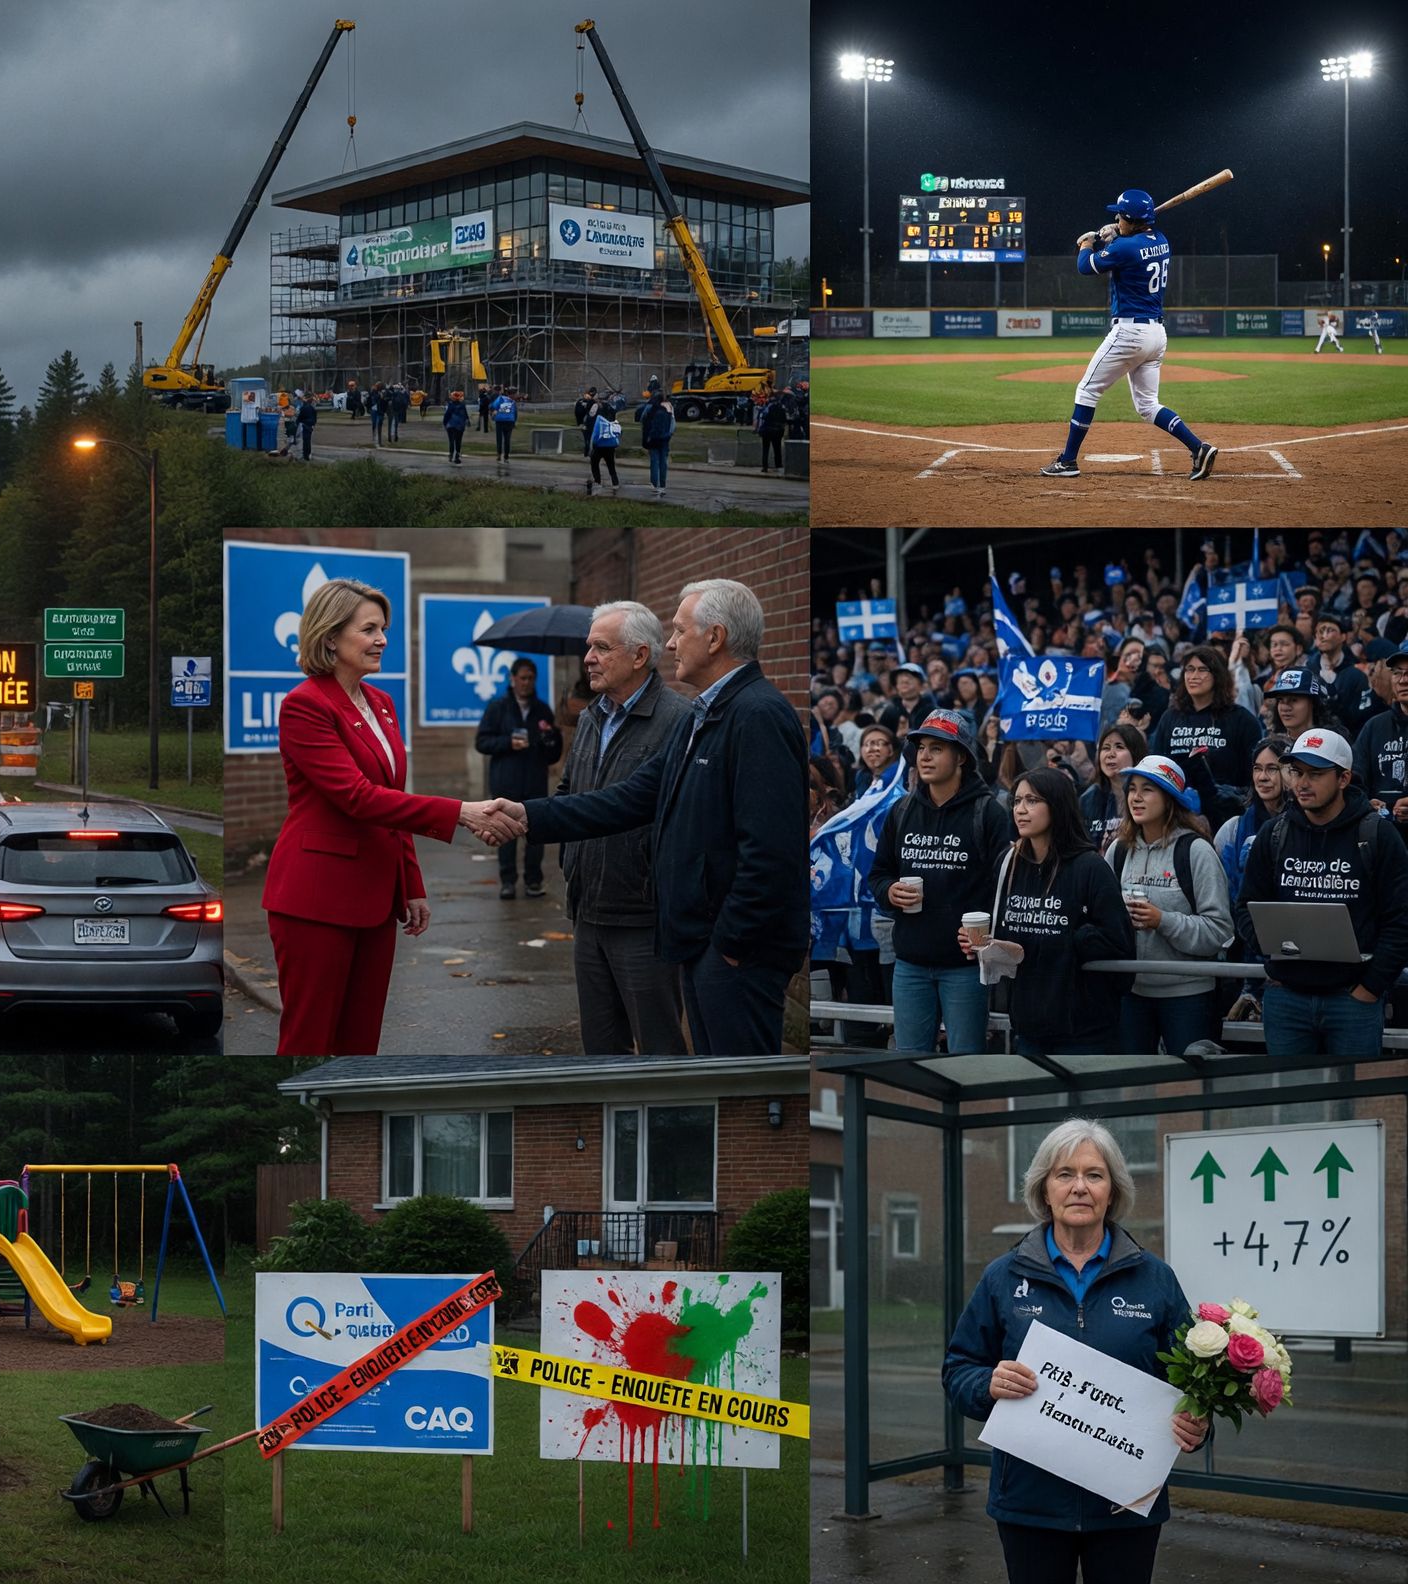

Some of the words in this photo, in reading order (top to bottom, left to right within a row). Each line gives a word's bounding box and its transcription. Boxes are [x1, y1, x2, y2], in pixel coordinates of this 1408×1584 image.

[1213, 1216, 1351, 1272] +4,7%
[335, 1302, 374, 1318] Parti
[290, 1384, 344, 1430] POLICE
[530, 1358, 593, 1390] POLICE
[611, 1374, 693, 1408] ENQUÊTE
[697, 1391, 723, 1415] EN
[727, 1397, 790, 1427] COURS
[404, 1405, 474, 1432] CAQ
